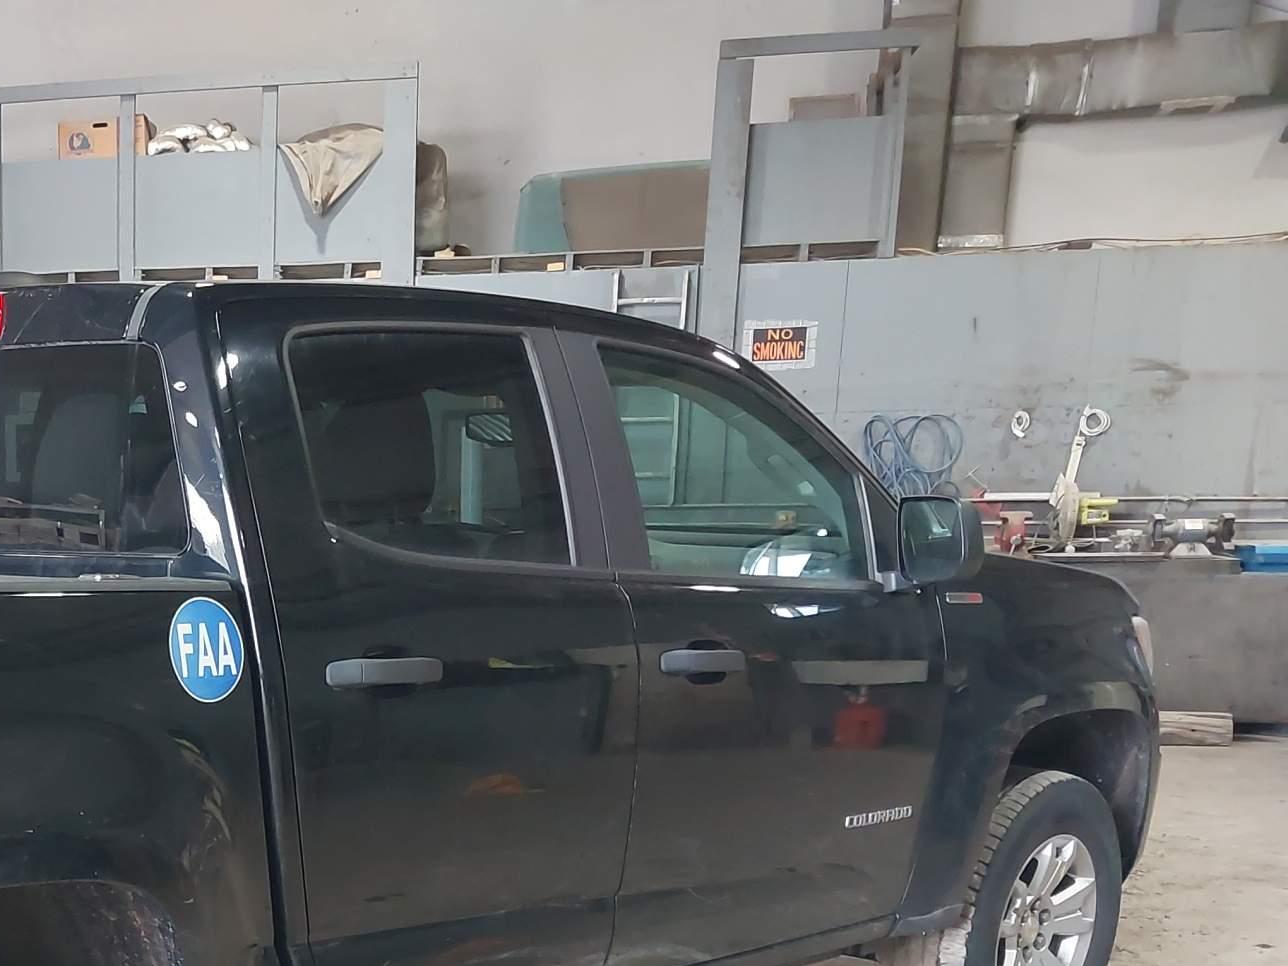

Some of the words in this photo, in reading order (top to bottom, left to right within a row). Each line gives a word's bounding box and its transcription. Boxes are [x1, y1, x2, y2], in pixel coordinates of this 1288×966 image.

[767, 329, 793, 341] NO
[753, 341, 805, 361] SMOKING
[176, 621, 238, 679] FAA
[844, 805, 913, 829] COLORADO
